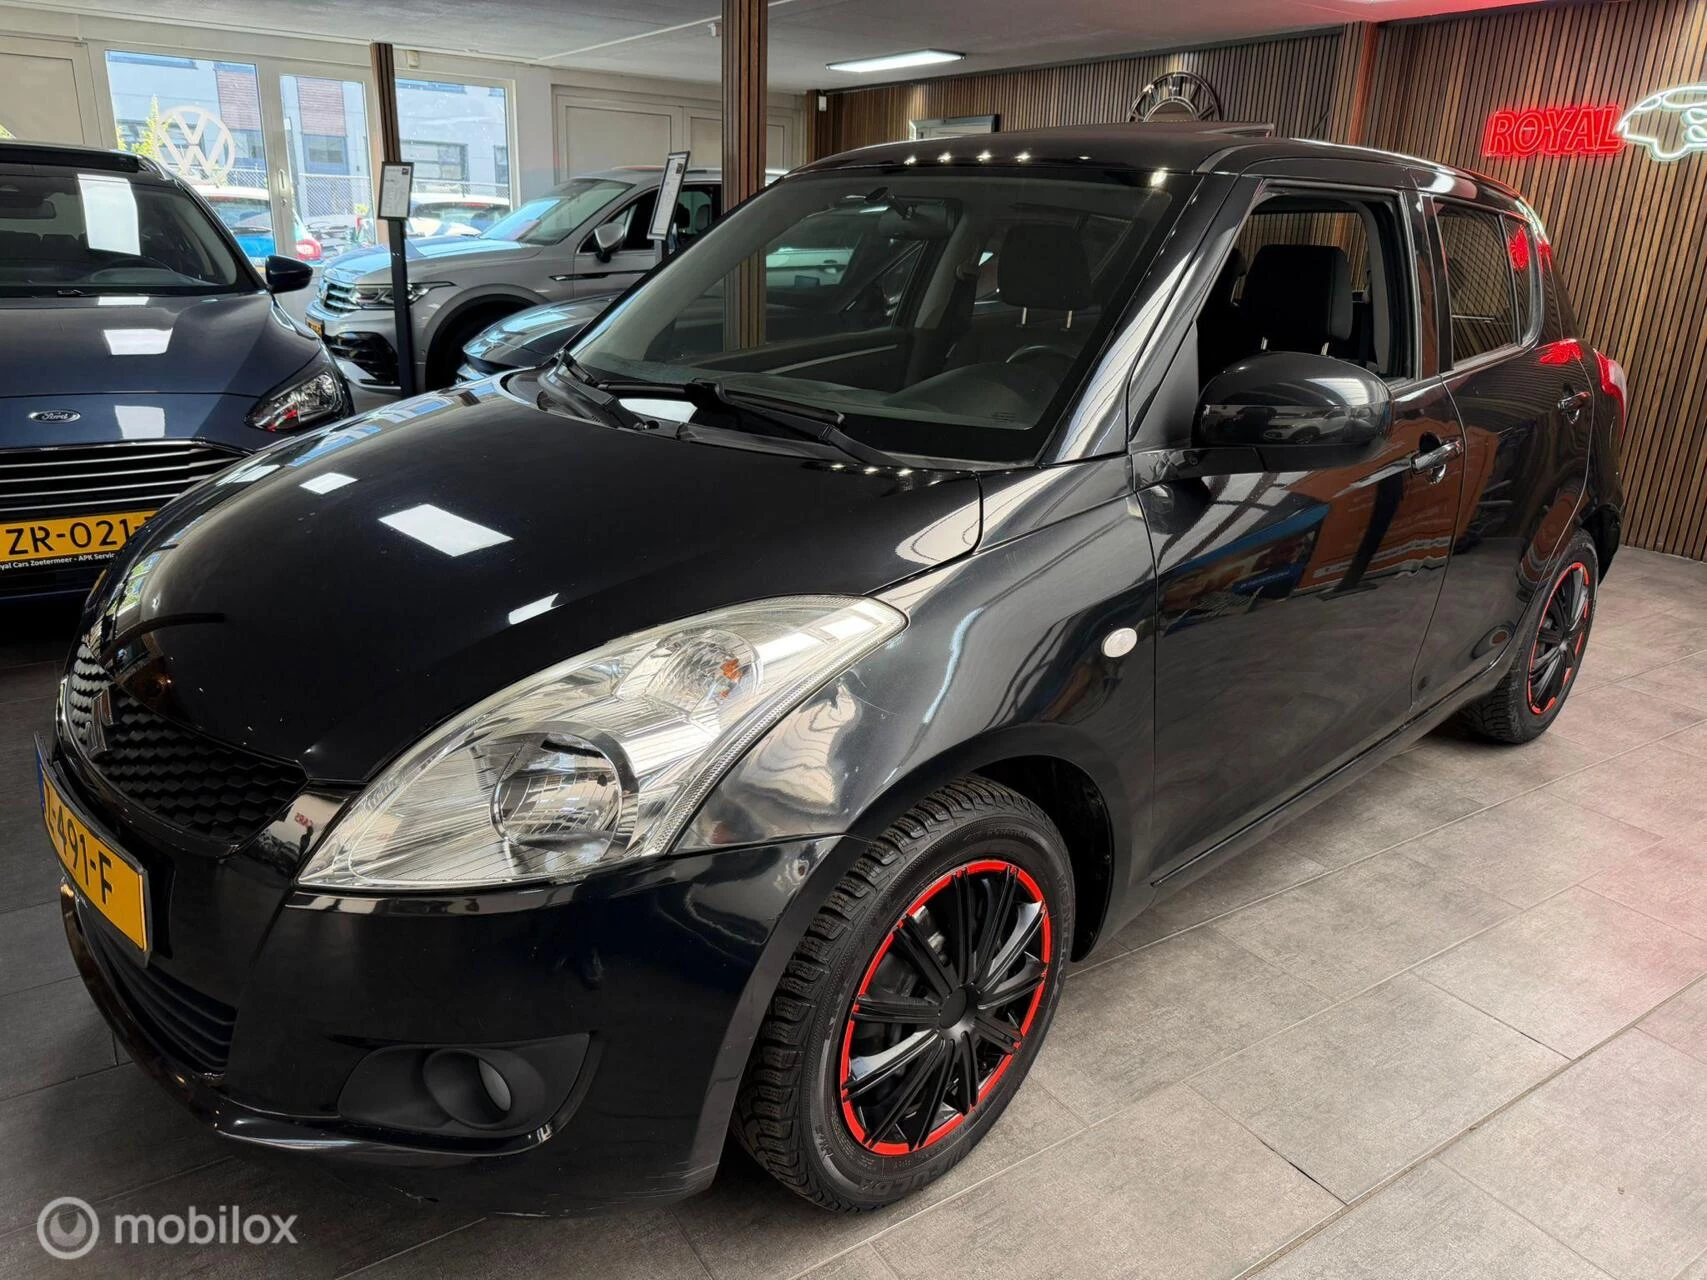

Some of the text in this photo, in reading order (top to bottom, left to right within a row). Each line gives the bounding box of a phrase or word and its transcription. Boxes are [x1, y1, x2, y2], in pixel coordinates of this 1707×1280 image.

[1486, 104, 1624, 155] ROYAL
[5, 516, 152, 555] ZR-021-
[12, 560, 29, 568] Cars
[30, 557, 72, 566] Zoetermeer
[78, 554, 94, 562] APK
[94, 552, 115, 560] Servic
